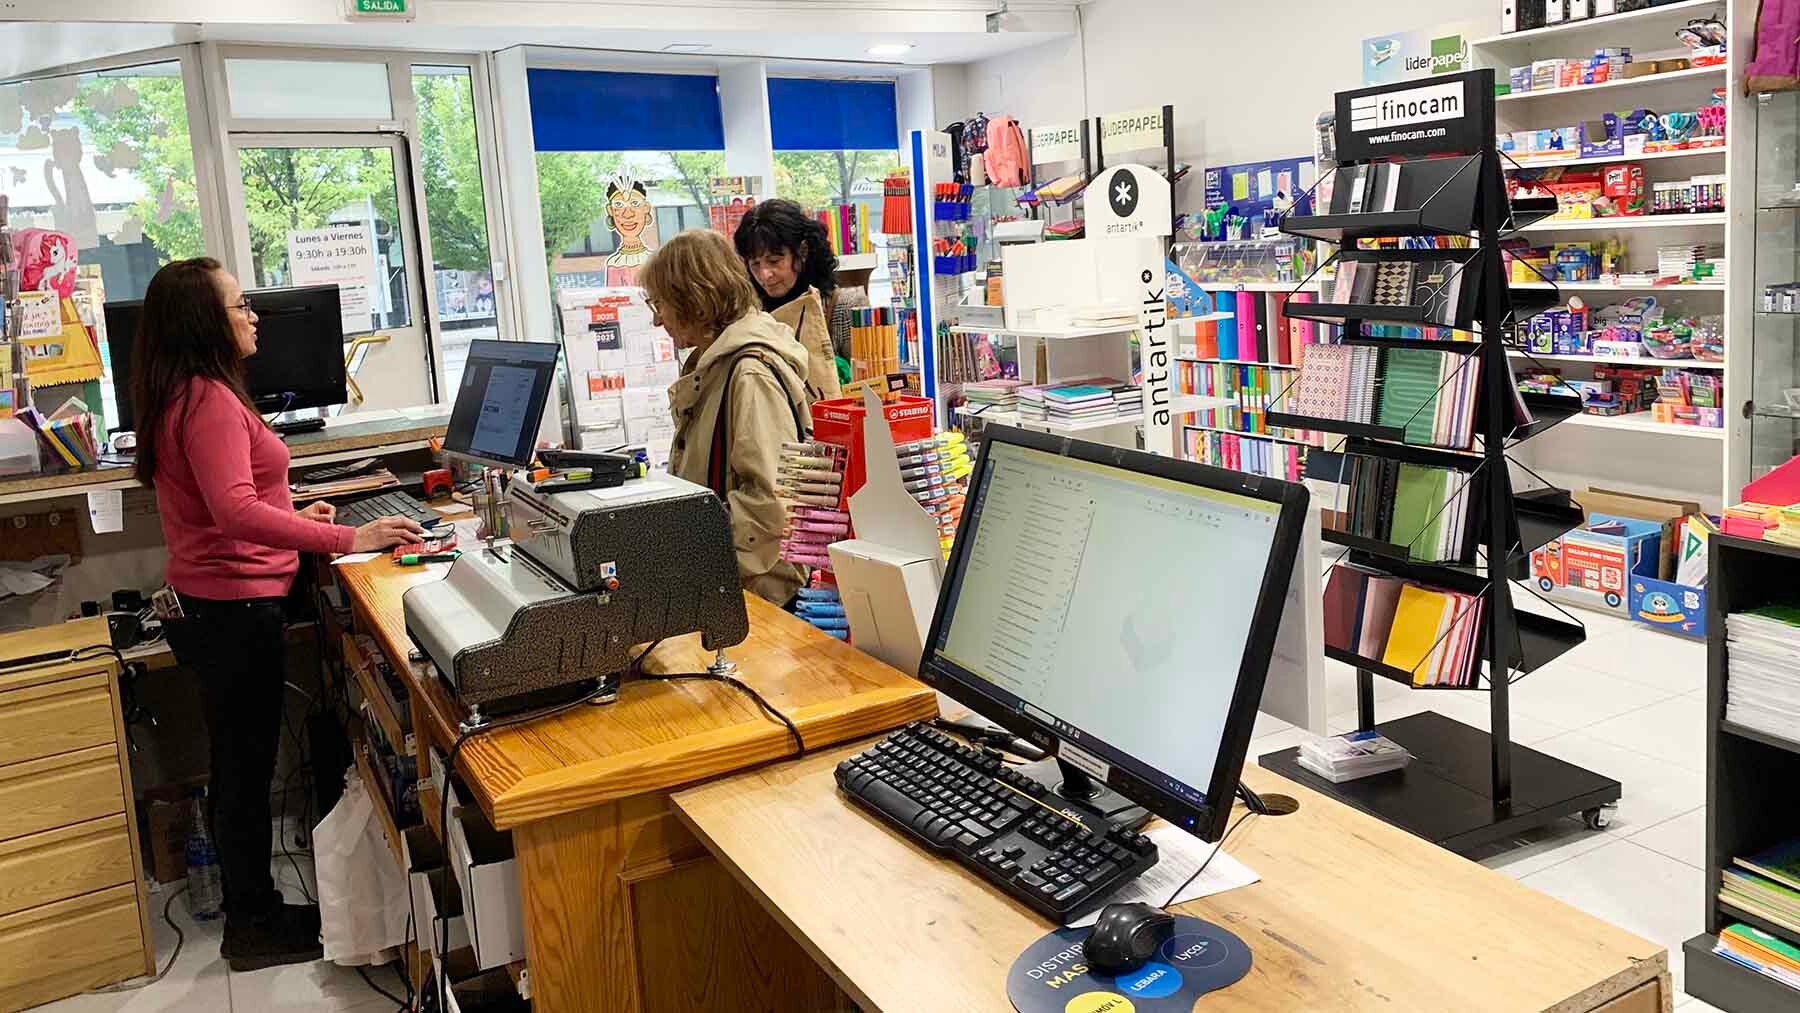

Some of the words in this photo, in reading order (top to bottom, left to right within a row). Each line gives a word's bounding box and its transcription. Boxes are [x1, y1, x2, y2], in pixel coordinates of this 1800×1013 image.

[363, 0, 400, 10] SALIDA
[1405, 40, 1468, 72] liderpapel
[1382, 95, 1459, 121] finocam
[1368, 127, 1447, 145] www.finocam.com
[1106, 222, 1140, 235] antartik
[295, 235, 321, 244] Lunes
[331, 232, 363, 241] Viernes
[296, 249, 324, 260] 9:30h
[335, 246, 367, 257] 19:30h
[1143, 288, 1170, 426] antartik
[899, 406, 929, 417] STABILO
[1026, 941, 1085, 980] DISTRIB
[1130, 970, 1167, 991] LEBARA
